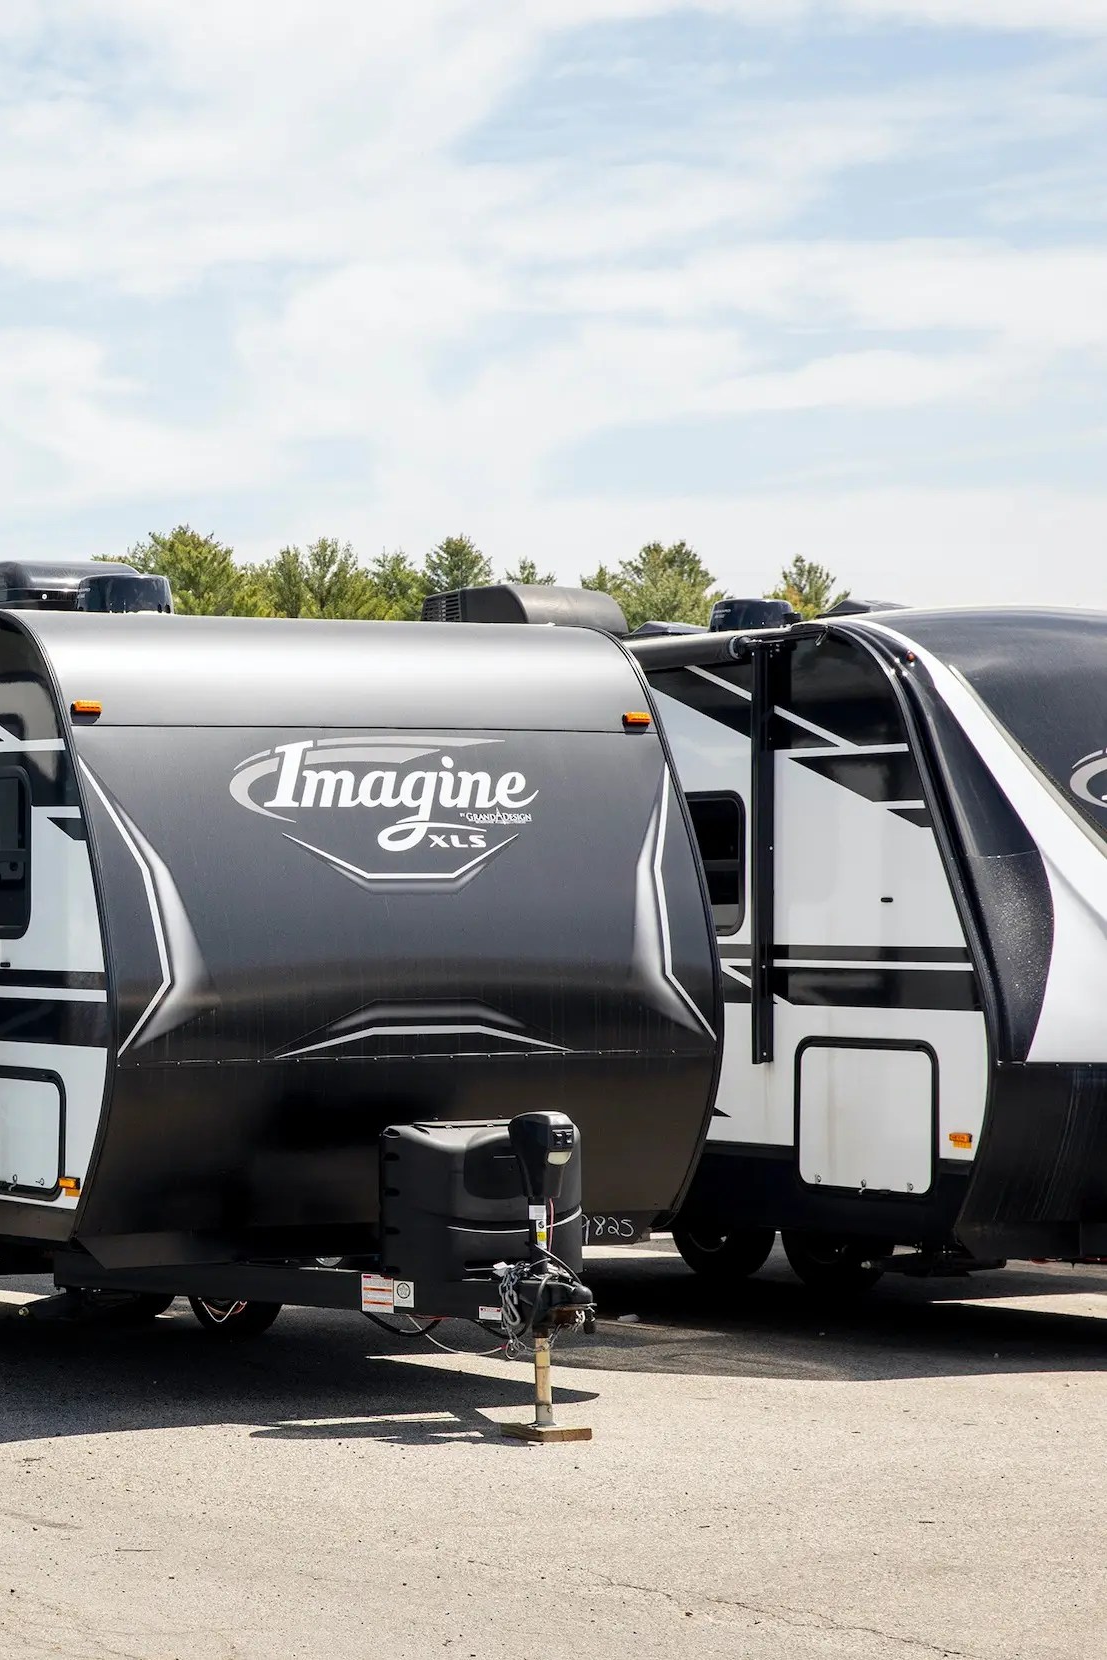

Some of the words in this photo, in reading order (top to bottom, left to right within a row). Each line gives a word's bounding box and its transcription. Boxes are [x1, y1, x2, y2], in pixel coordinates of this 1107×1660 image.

[263, 739, 540, 852] Imagine
[465, 812, 495, 822] GRAND
[501, 812, 532, 822] DESIGN
[427, 834, 487, 848] XLS
